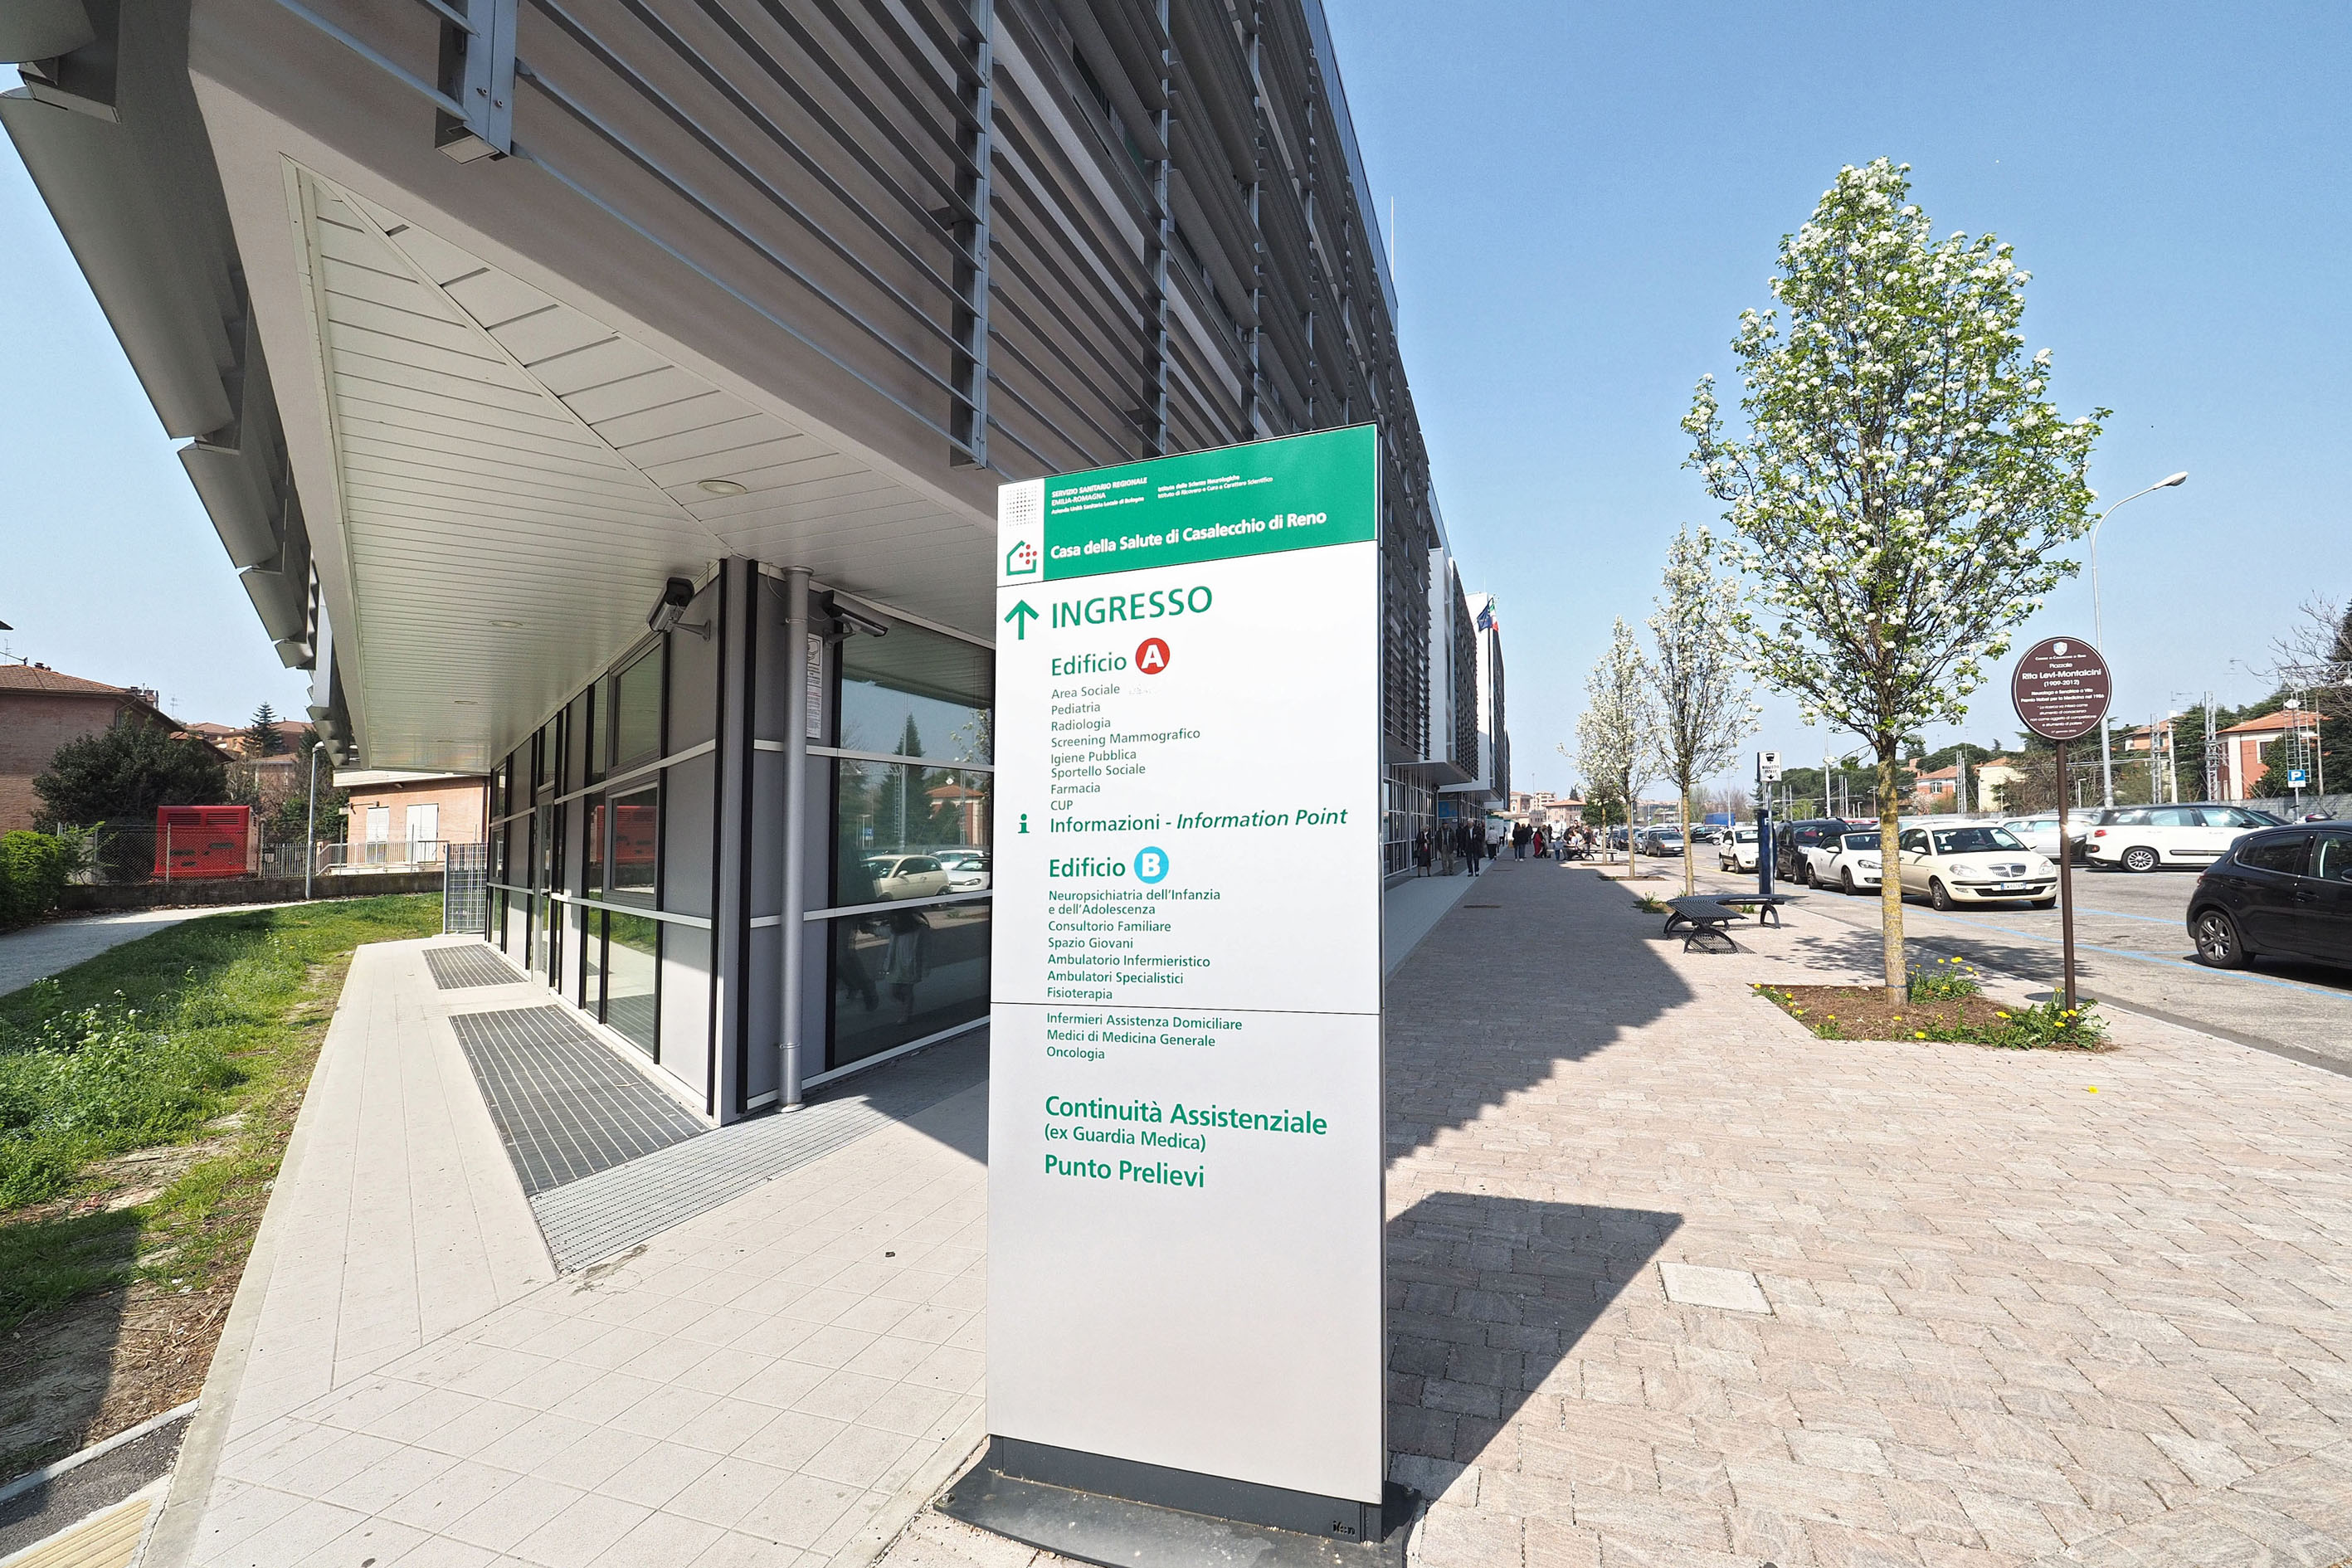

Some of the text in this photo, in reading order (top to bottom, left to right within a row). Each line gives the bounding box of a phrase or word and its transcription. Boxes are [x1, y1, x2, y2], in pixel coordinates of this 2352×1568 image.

[1079, 483, 1111, 493] SANITARIO
[1113, 477, 1147, 488] REGIONALE
[1051, 493, 1106, 506] EMILIA-ROMAGNA
[1050, 512, 1327, 559] Casa della Salute di Casalecchio di Reno
[1052, 586, 1213, 629] INGRESSO
[1051, 644, 1165, 677] Edificio A
[2039, 669, 2101, 679] Levi-Montalcini
[1051, 689, 1078, 699] Area
[1081, 683, 1120, 697] Sociale
[1051, 704, 1100, 715] Pediatria
[1051, 719, 1111, 732] Radiologia
[1051, 728, 1200, 748] Screening Mammografico
[1051, 749, 1137, 767] Igiene Pubblica
[1051, 762, 1146, 781] Sportello Sociale
[2291, 771, 2302, 781] P
[1050, 784, 1101, 795] Farmacia
[1050, 800, 1074, 811] CUP
[1050, 813, 1160, 833] Informazioni
[1176, 811, 1289, 830] Information
[1295, 807, 1348, 825] Point
[1049, 852, 1161, 878] Edificio B
[1049, 889, 1220, 903] Neuropsichiatria dell'Infanzia
[1048, 903, 1156, 915] e dell'Adolescenza
[1048, 920, 1171, 933] Consultorio Familiare
[1048, 937, 1133, 951] Spazio Giovani
[1047, 953, 1210, 967] Ambulatorio Infermieristico
[1047, 970, 1184, 986] Ambulatori Specialistici
[1047, 986, 1113, 1002] Fisioterapia
[1047, 1011, 1243, 1030] Infermieri Assistenza Domiciliare
[1047, 1029, 1215, 1047] Medici di Medicina Generale
[1046, 1045, 1105, 1062] Oncologia
[1045, 1095, 1328, 1137] Continuità Assistenziale
[1045, 1122, 1206, 1153] (ex Guardia Medica)
[1045, 1153, 1205, 1188] Punto Prelievi
